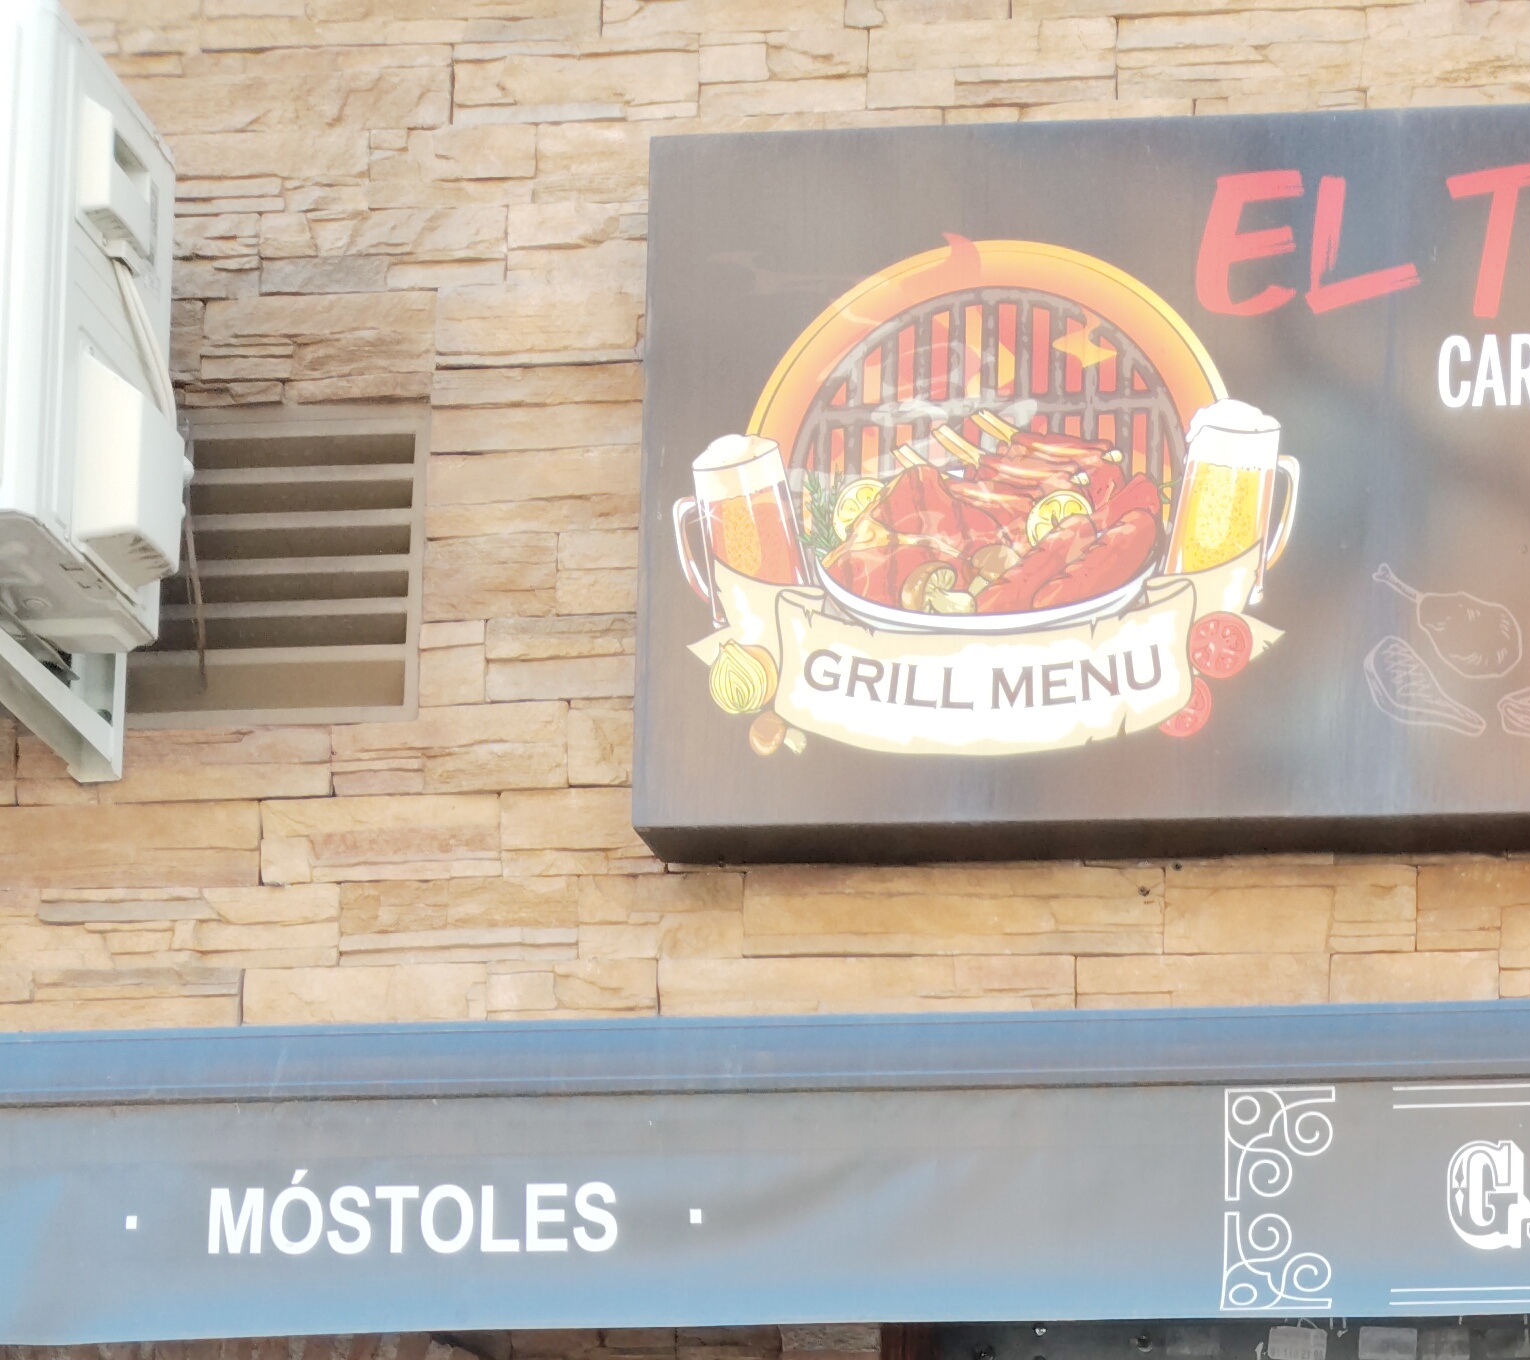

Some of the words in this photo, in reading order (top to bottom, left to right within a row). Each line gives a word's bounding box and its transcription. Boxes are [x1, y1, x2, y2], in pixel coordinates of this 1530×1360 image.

[1196, 167, 1422, 317] EL
[803, 647, 975, 713] GRILL
[990, 643, 1164, 711] MENU
[207, 1168, 619, 1256] MÓSTOLES
